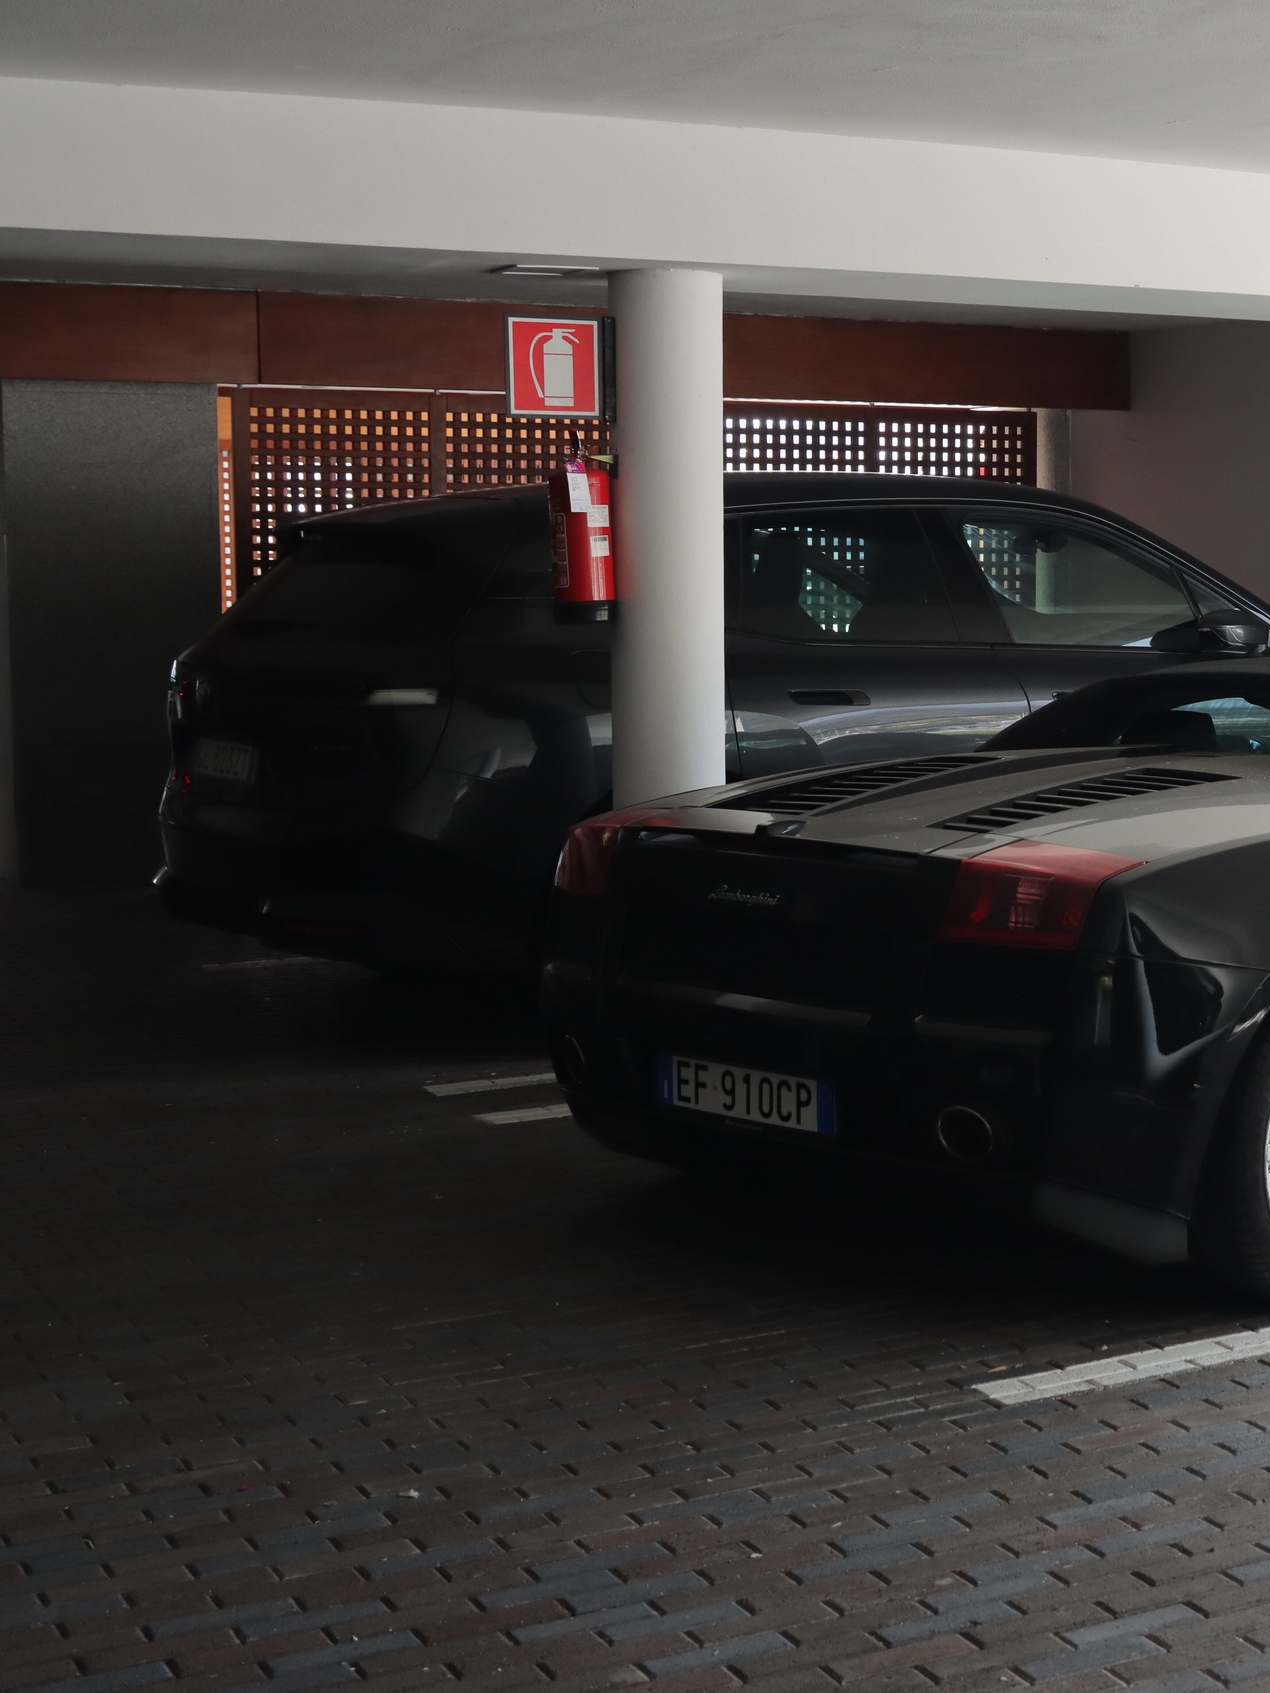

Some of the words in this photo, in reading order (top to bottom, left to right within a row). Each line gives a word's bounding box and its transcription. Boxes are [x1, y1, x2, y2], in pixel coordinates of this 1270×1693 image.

[708, 884, 780, 907] Lamborghini
[677, 1060, 708, 1105] EF
[721, 1069, 812, 1125] 910CP
